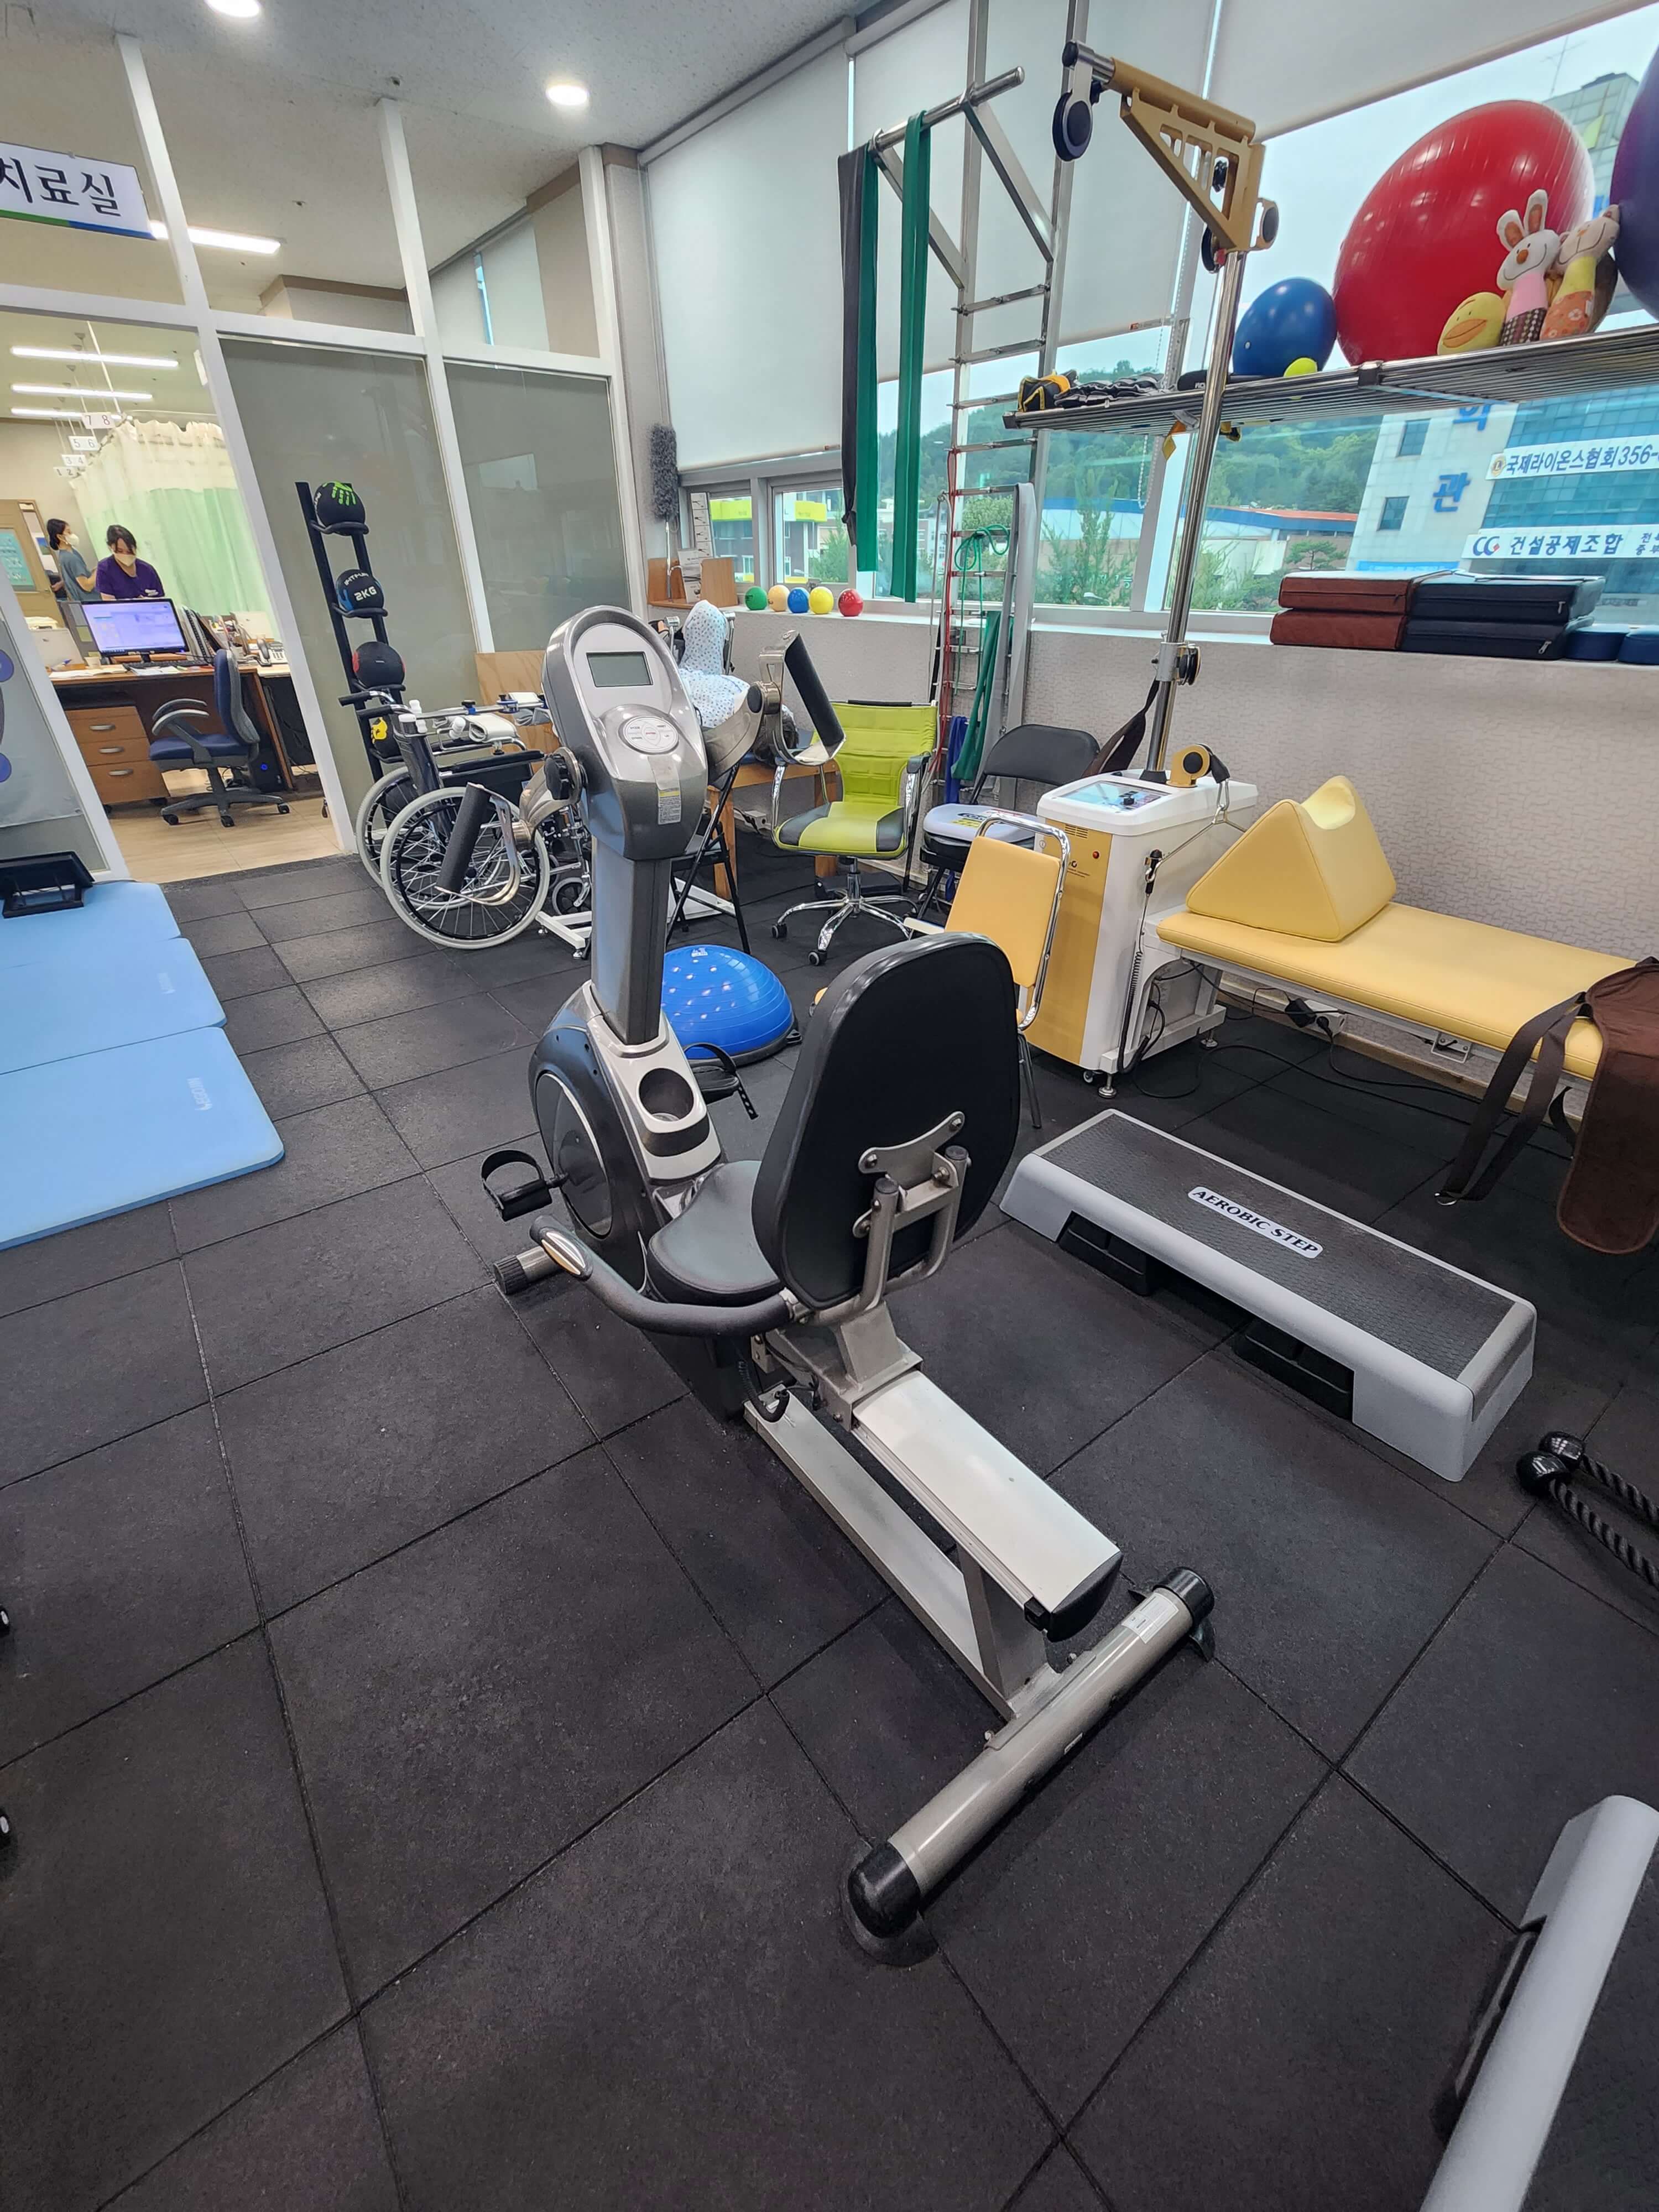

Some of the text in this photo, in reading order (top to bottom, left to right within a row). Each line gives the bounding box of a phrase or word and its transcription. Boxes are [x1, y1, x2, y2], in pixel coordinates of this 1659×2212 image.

[85, 415, 110, 425] 7 8
[73, 439, 95, 448] 5 6
[65, 456, 72, 465] 3
[1510, 533, 1624, 556] 건설공제조합
[353, 586, 378, 602] 2KG
[1192, 1190, 1318, 1252] AEROBIC STEP
